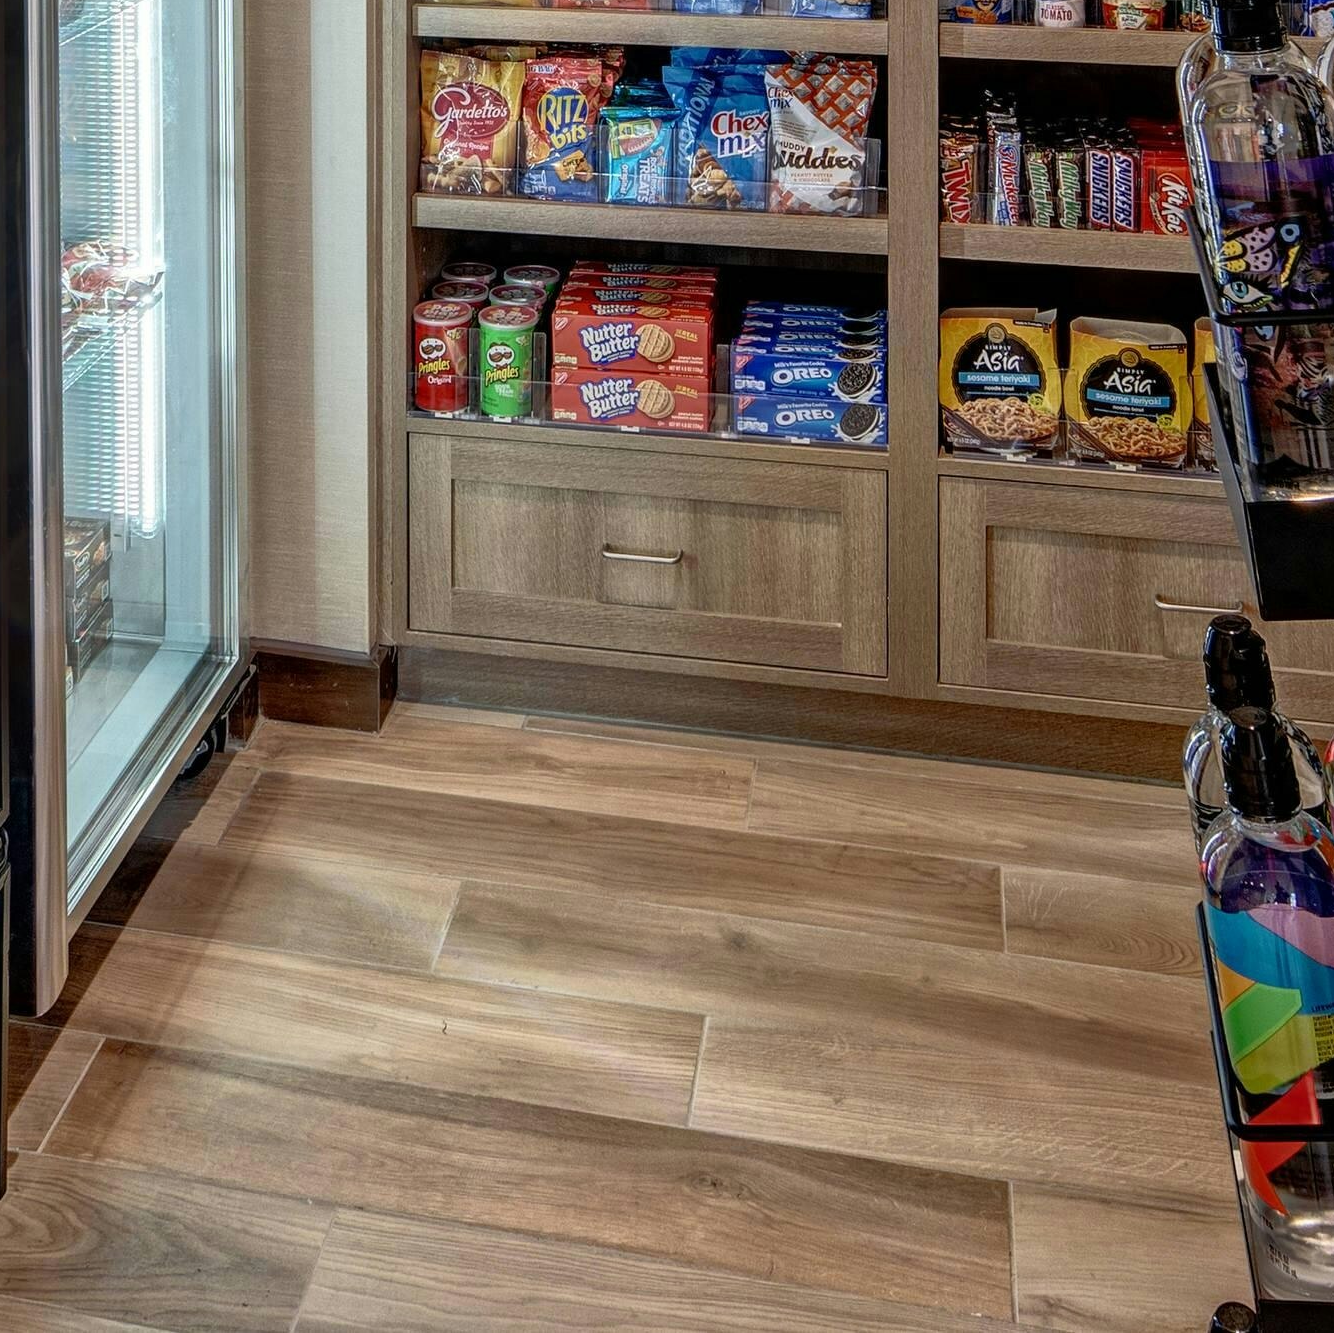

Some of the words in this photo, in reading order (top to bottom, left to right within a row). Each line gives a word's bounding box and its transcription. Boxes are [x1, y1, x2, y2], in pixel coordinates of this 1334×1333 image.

[1040, 8, 1073, 21] TOMATO
[768, 86, 794, 98] Chex
[770, 98, 793, 109] mix
[432, 87, 508, 138] Gardetto's
[541, 94, 586, 131] RITZ
[711, 112, 769, 134] Chex
[551, 125, 587, 149] bits
[718, 132, 768, 158] mix
[637, 158, 649, 203] TREATS
[1091, 151, 1111, 225] SNICKERS
[1114, 152, 1134, 229] SNICKERS
[581, 323, 632, 347] Nutter
[589, 336, 639, 362] Butter
[973, 349, 1020, 372] Asia
[419, 359, 450, 378] Pringles
[486, 367, 518, 386] Pringles
[773, 368, 832, 384] OREO
[967, 374, 999, 383] sesame
[1001, 373, 1030, 384] teriyaki
[1117, 367, 1145, 375] SIMPLY
[581, 379, 632, 402] Nutter
[1103, 371, 1153, 395] Asia
[588, 391, 639, 418] Butter
[1095, 391, 1129, 403] sesame
[1131, 394, 1162, 406] teriyaki
[775, 409, 834, 426] OREO
